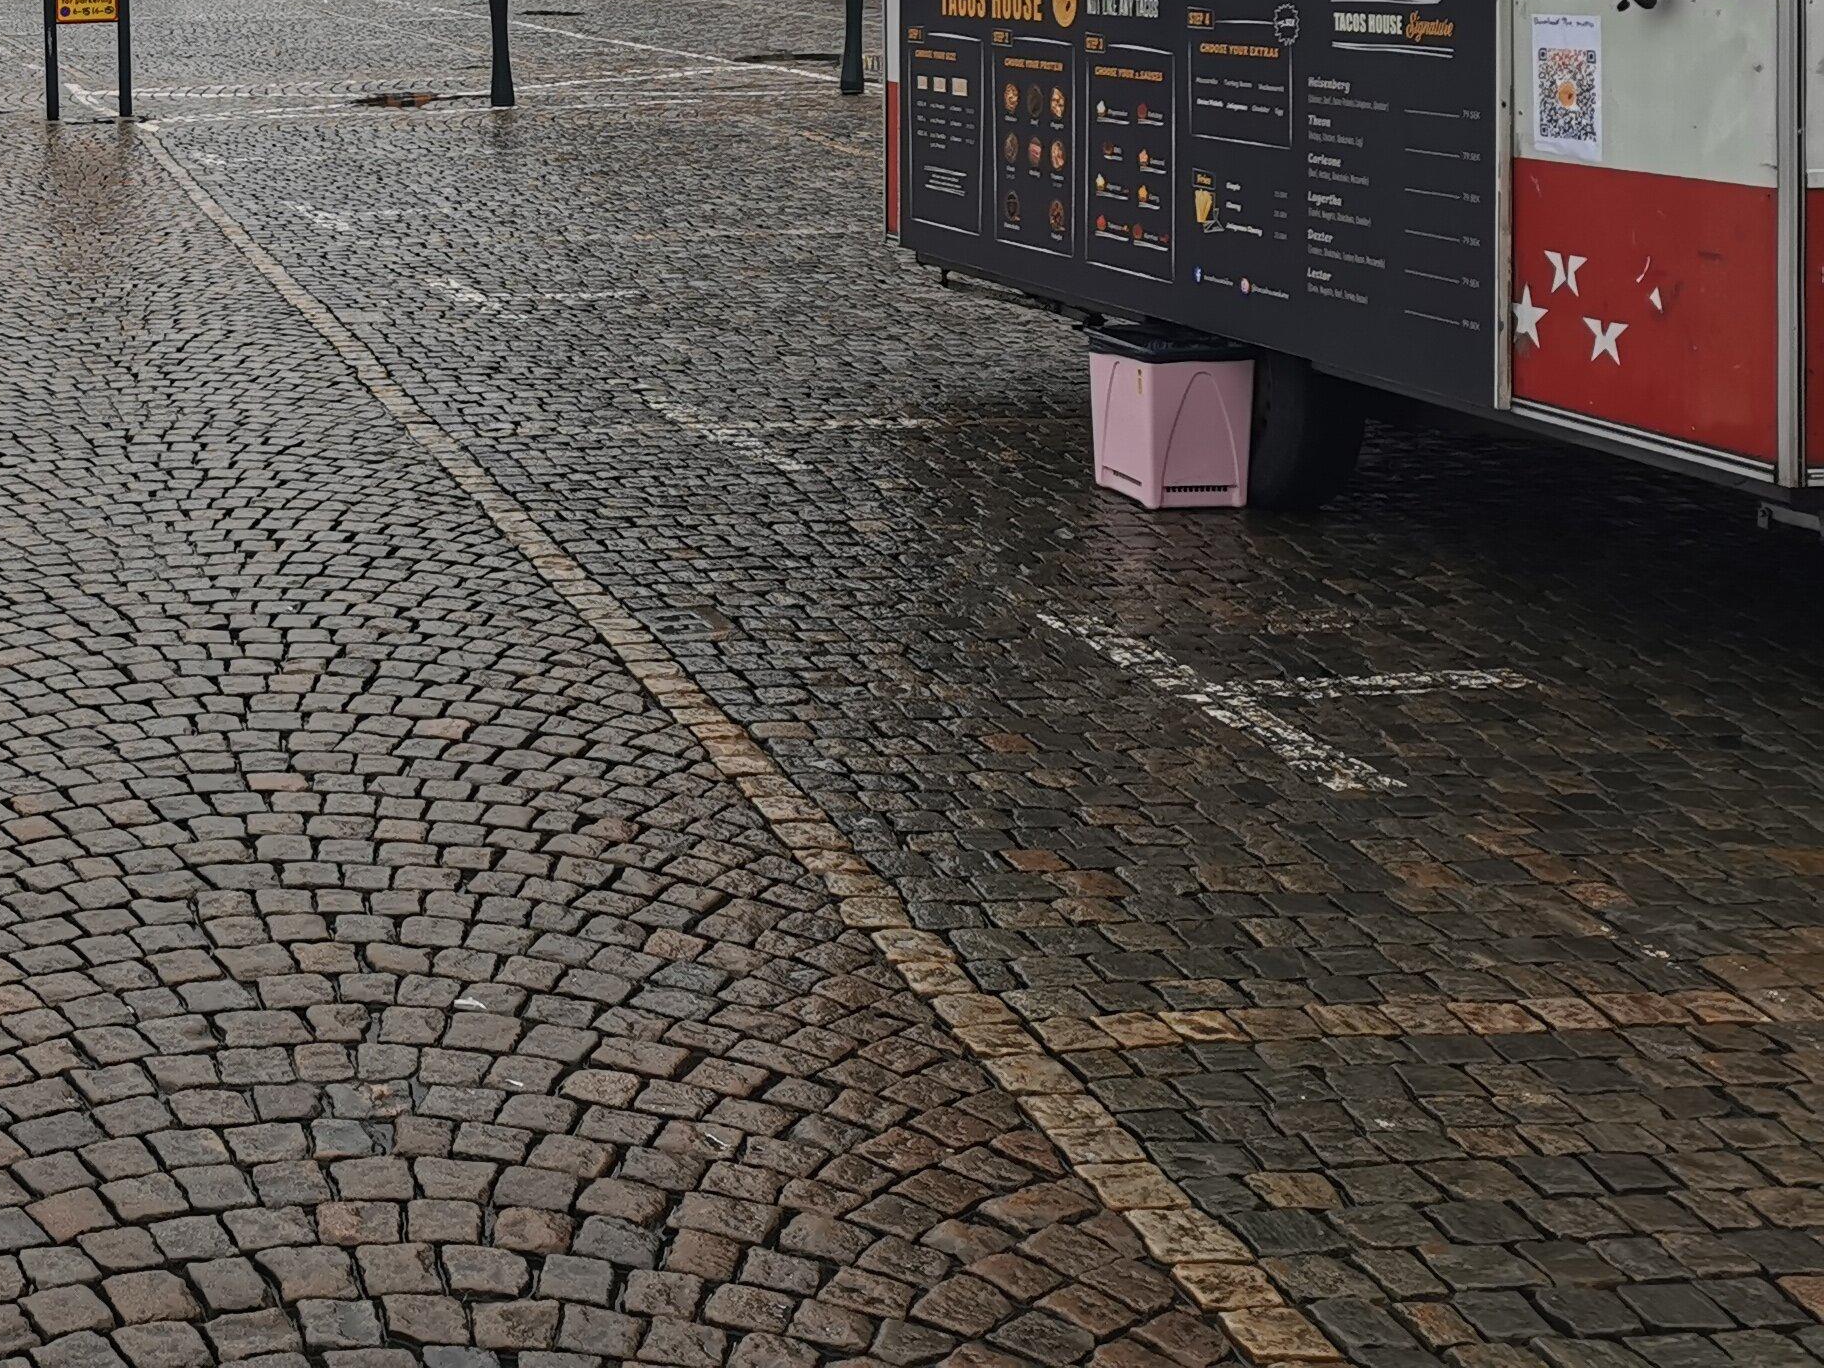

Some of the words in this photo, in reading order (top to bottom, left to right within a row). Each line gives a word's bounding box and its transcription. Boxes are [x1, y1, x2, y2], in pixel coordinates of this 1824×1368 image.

[1333, 12, 1366, 33] TACOS
[1368, 14, 1403, 35] HOUSE
[1200, 43, 1227, 54] CHOOSE
[1229, 45, 1248, 56] YOUR
[1250, 46, 1279, 58] EXTRAS
